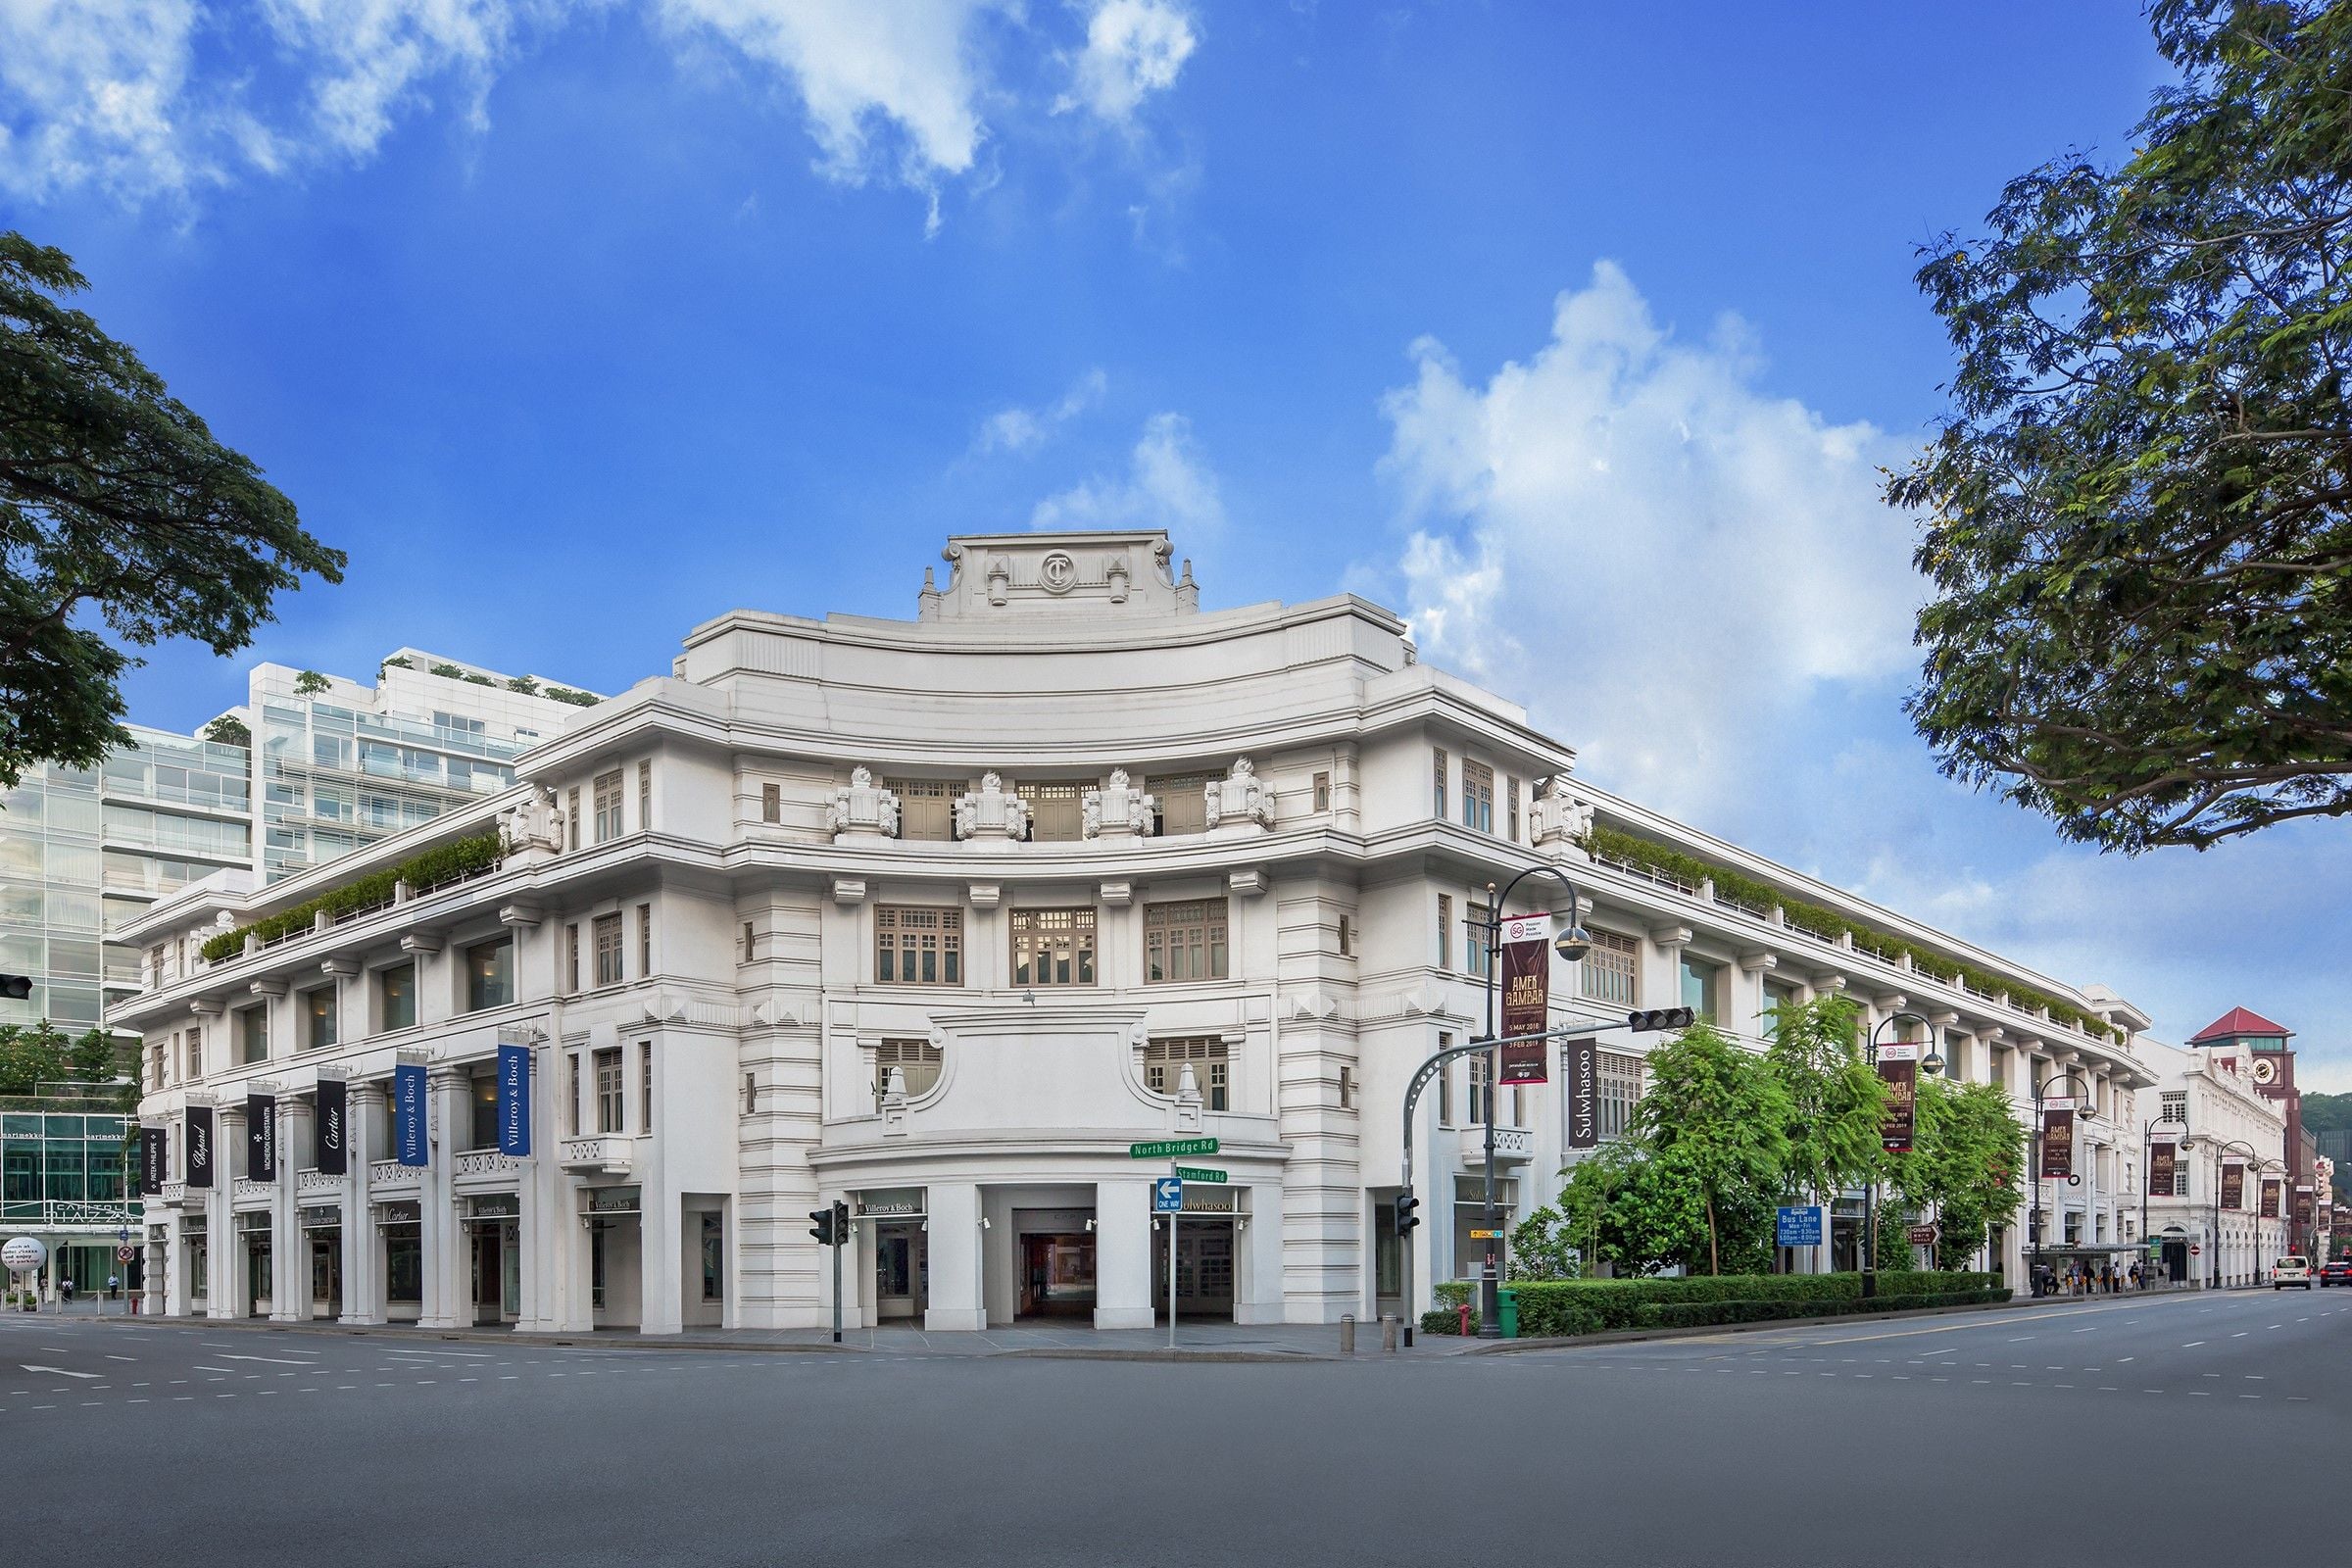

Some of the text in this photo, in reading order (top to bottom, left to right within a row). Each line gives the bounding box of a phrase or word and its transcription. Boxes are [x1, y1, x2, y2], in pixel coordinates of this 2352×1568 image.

[1512, 975, 1538, 991] AMEK
[1505, 989, 1544, 1006] GAMBAR
[508, 1055, 518, 1087] Boch
[509, 1089, 518, 1098] &
[1575, 1050, 1592, 1138] Sulwhasoo
[404, 1074, 417, 1159] Villeroy & Boch
[508, 1101, 521, 1148] Villeroy
[324, 1106, 340, 1150] Cartier
[192, 1124, 209, 1168] Chopard
[1135, 1140, 1213, 1155] North Bridge Rd
[1178, 1168, 1225, 1182] Stamford Rd
[864, 1203, 889, 1213] Villeroy
[896, 1202, 913, 1211] Boch
[1183, 1198, 1232, 1211] ulwhasoo
[45, 1211, 135, 1223] PIAZZA
[388, 1207, 410, 1221] Cartier
